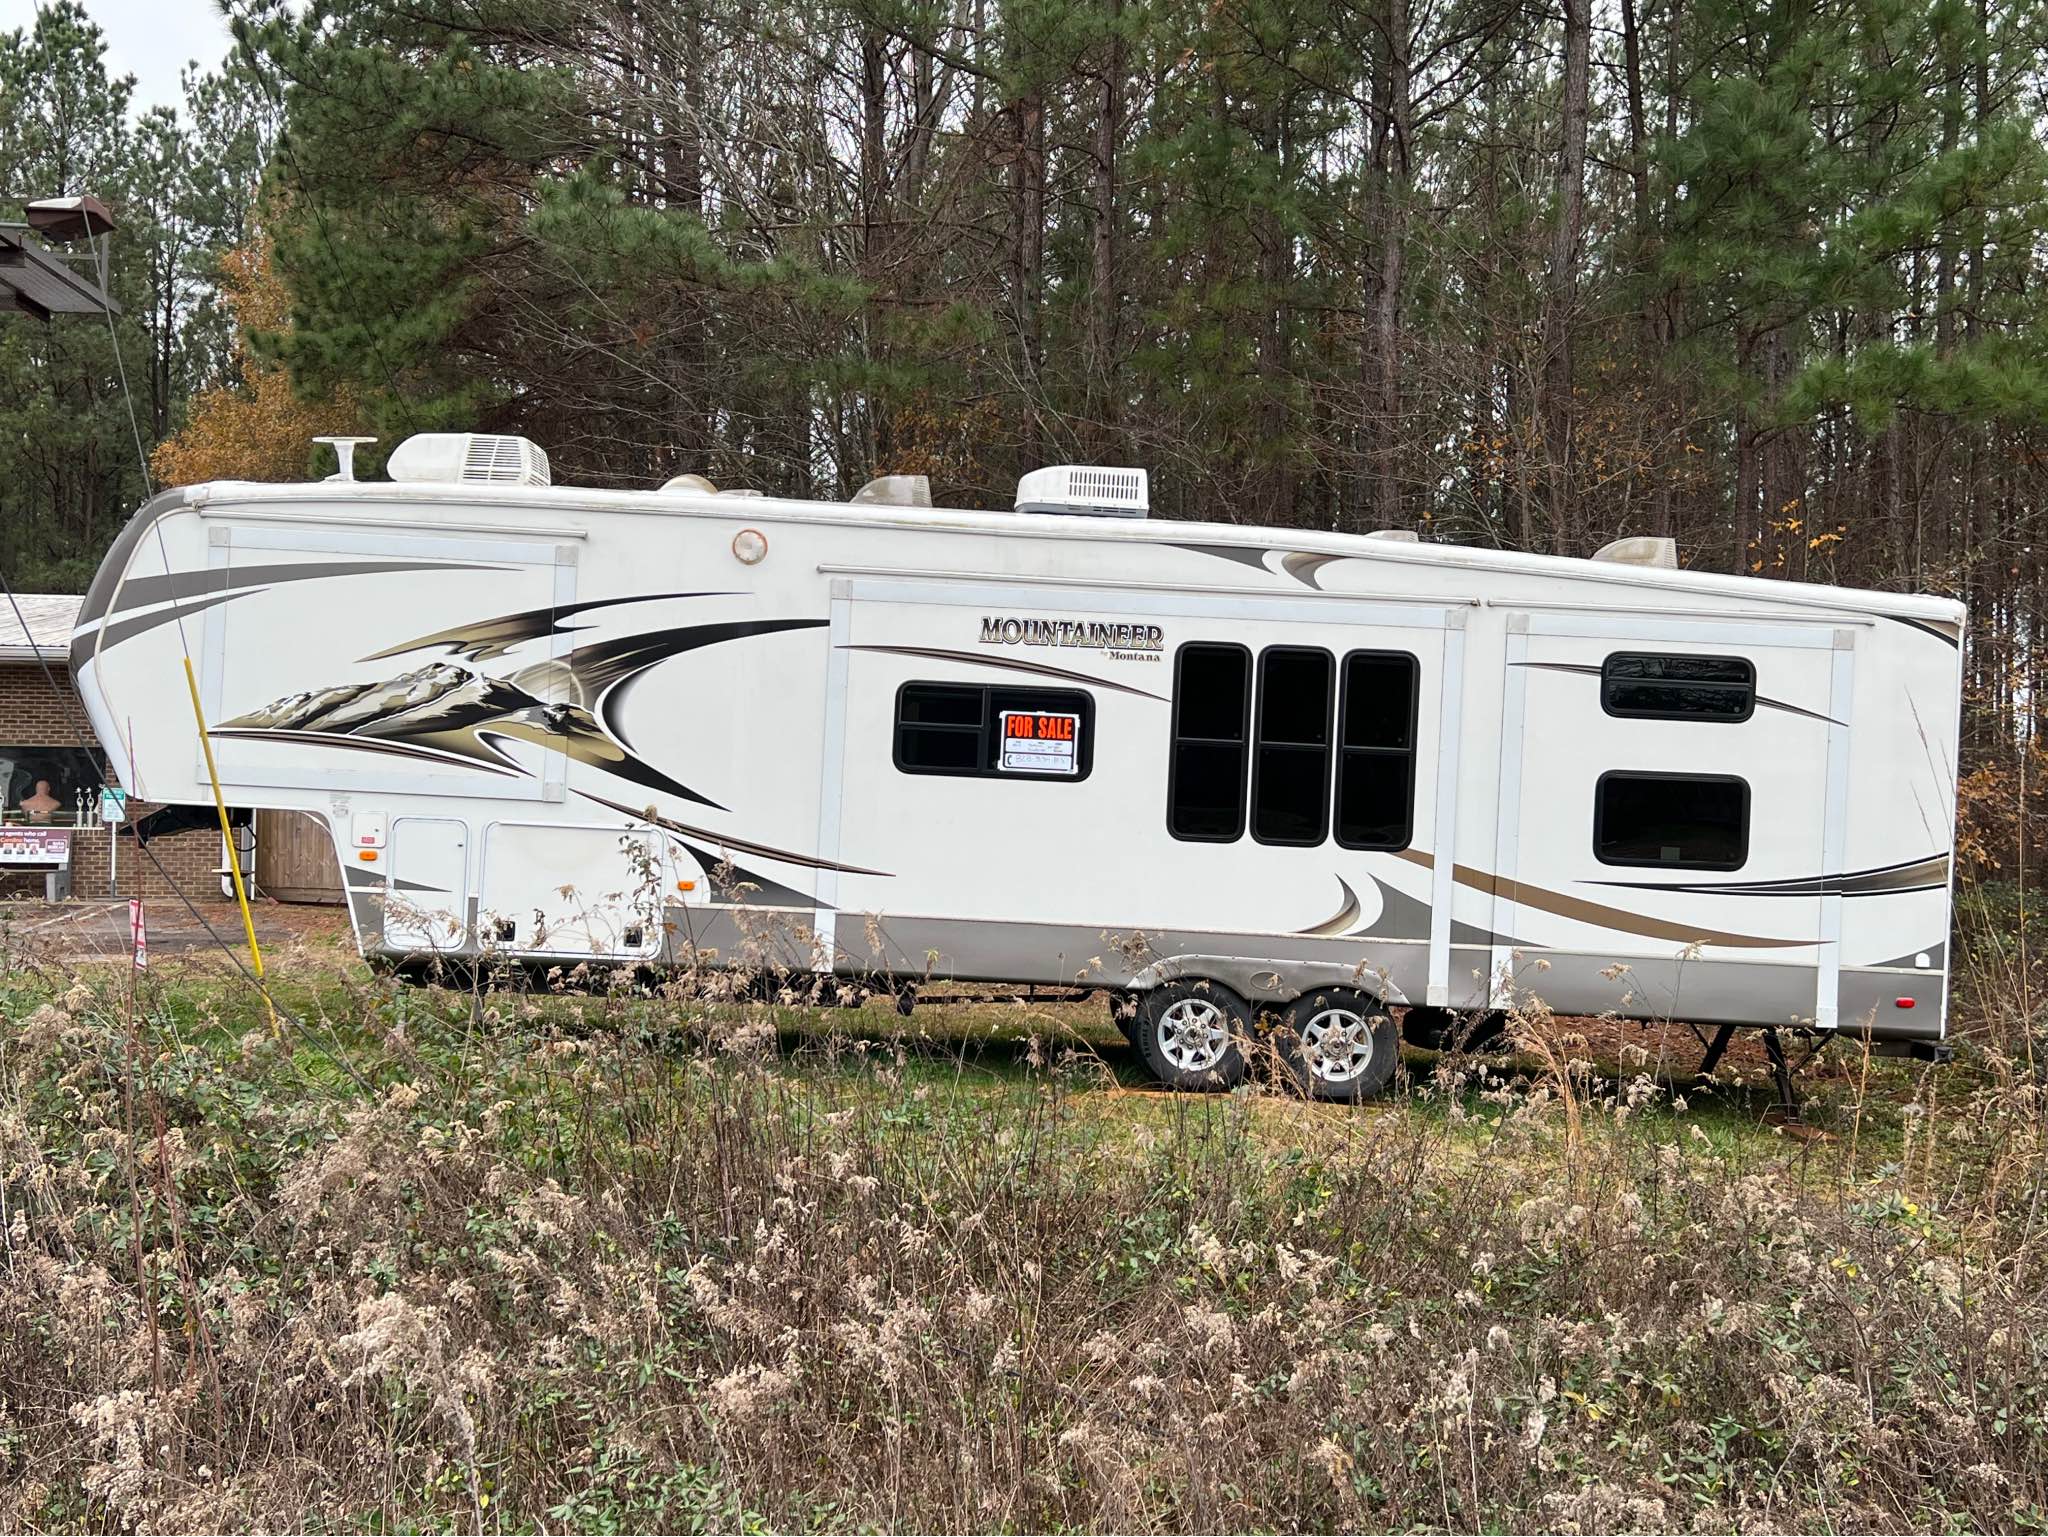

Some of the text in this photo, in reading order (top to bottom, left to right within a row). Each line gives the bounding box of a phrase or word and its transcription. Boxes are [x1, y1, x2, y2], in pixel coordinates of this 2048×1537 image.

[979, 616, 1164, 651] MOUNTAINEER
[1109, 651, 1160, 662] Montana
[1007, 715, 1073, 740] FOR SALE
